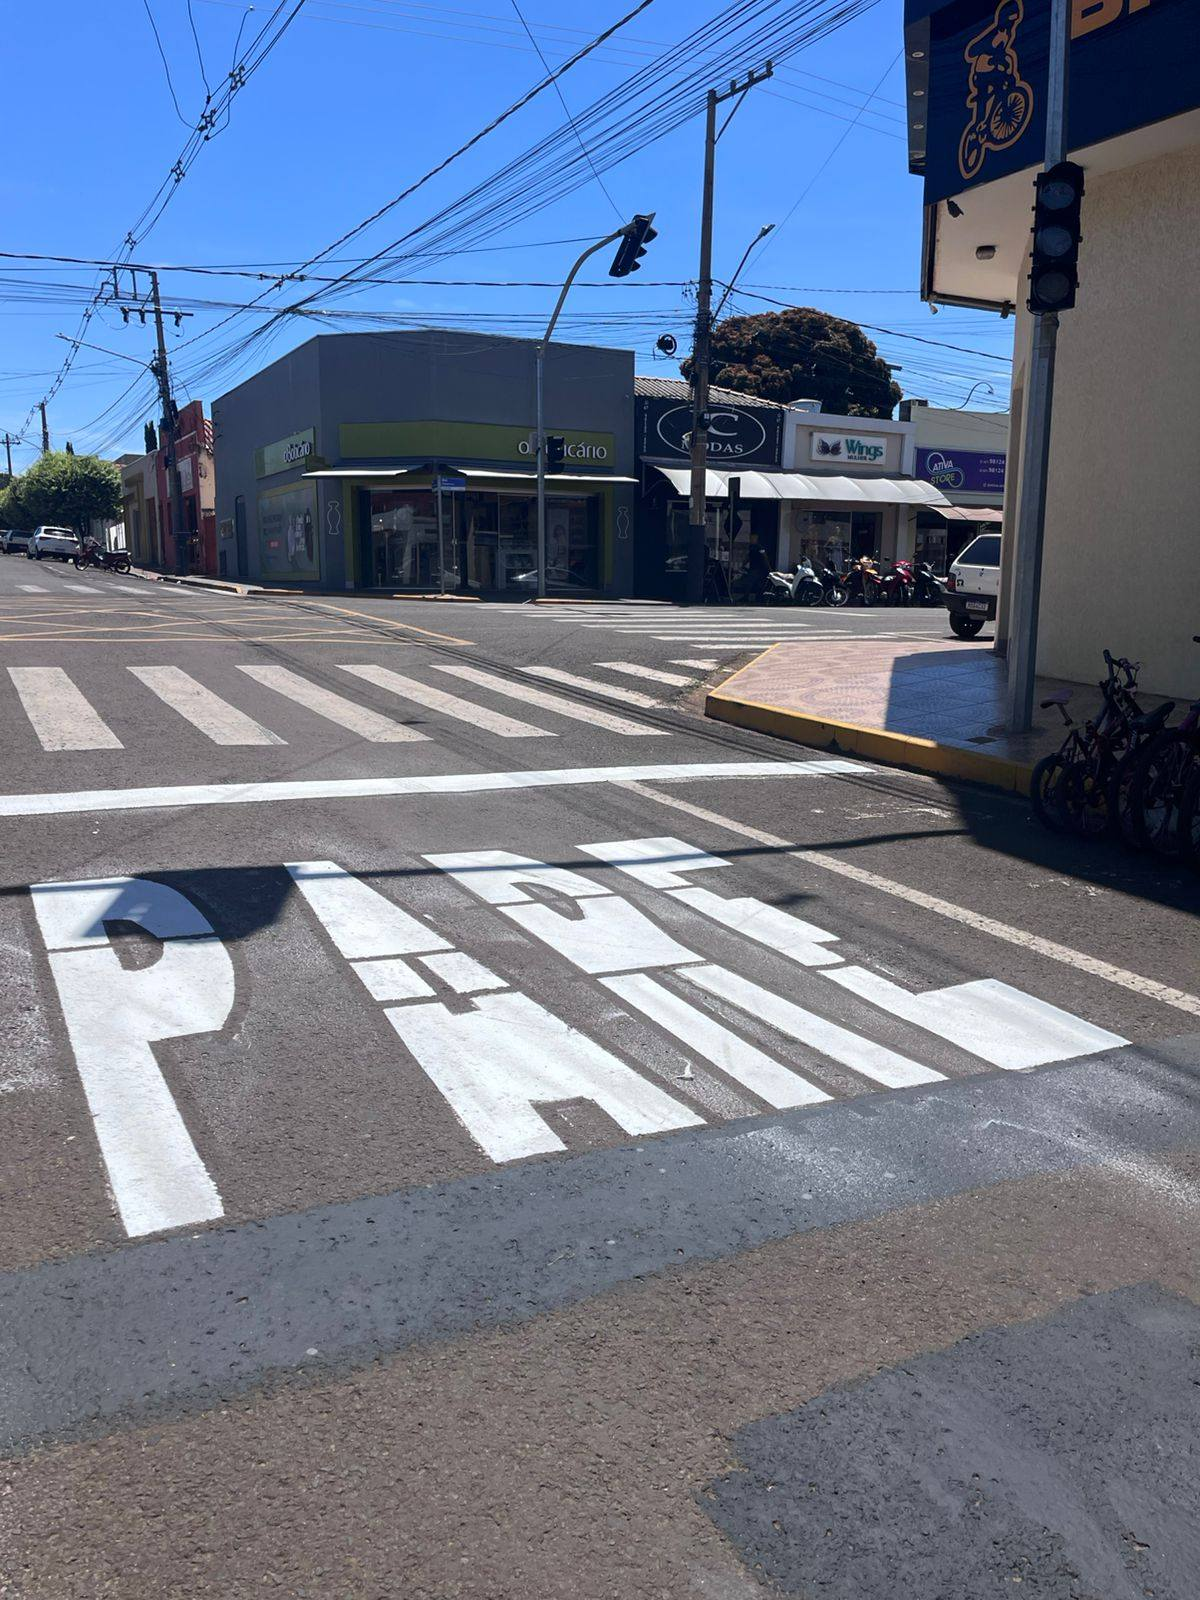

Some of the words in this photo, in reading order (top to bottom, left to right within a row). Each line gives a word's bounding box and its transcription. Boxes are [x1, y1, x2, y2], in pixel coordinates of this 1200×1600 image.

[845, 438, 883, 461] Wings
[933, 460, 954, 471] ATIVA
[930, 473, 955, 485] STORE
[30, 836, 1132, 1238] PARE
